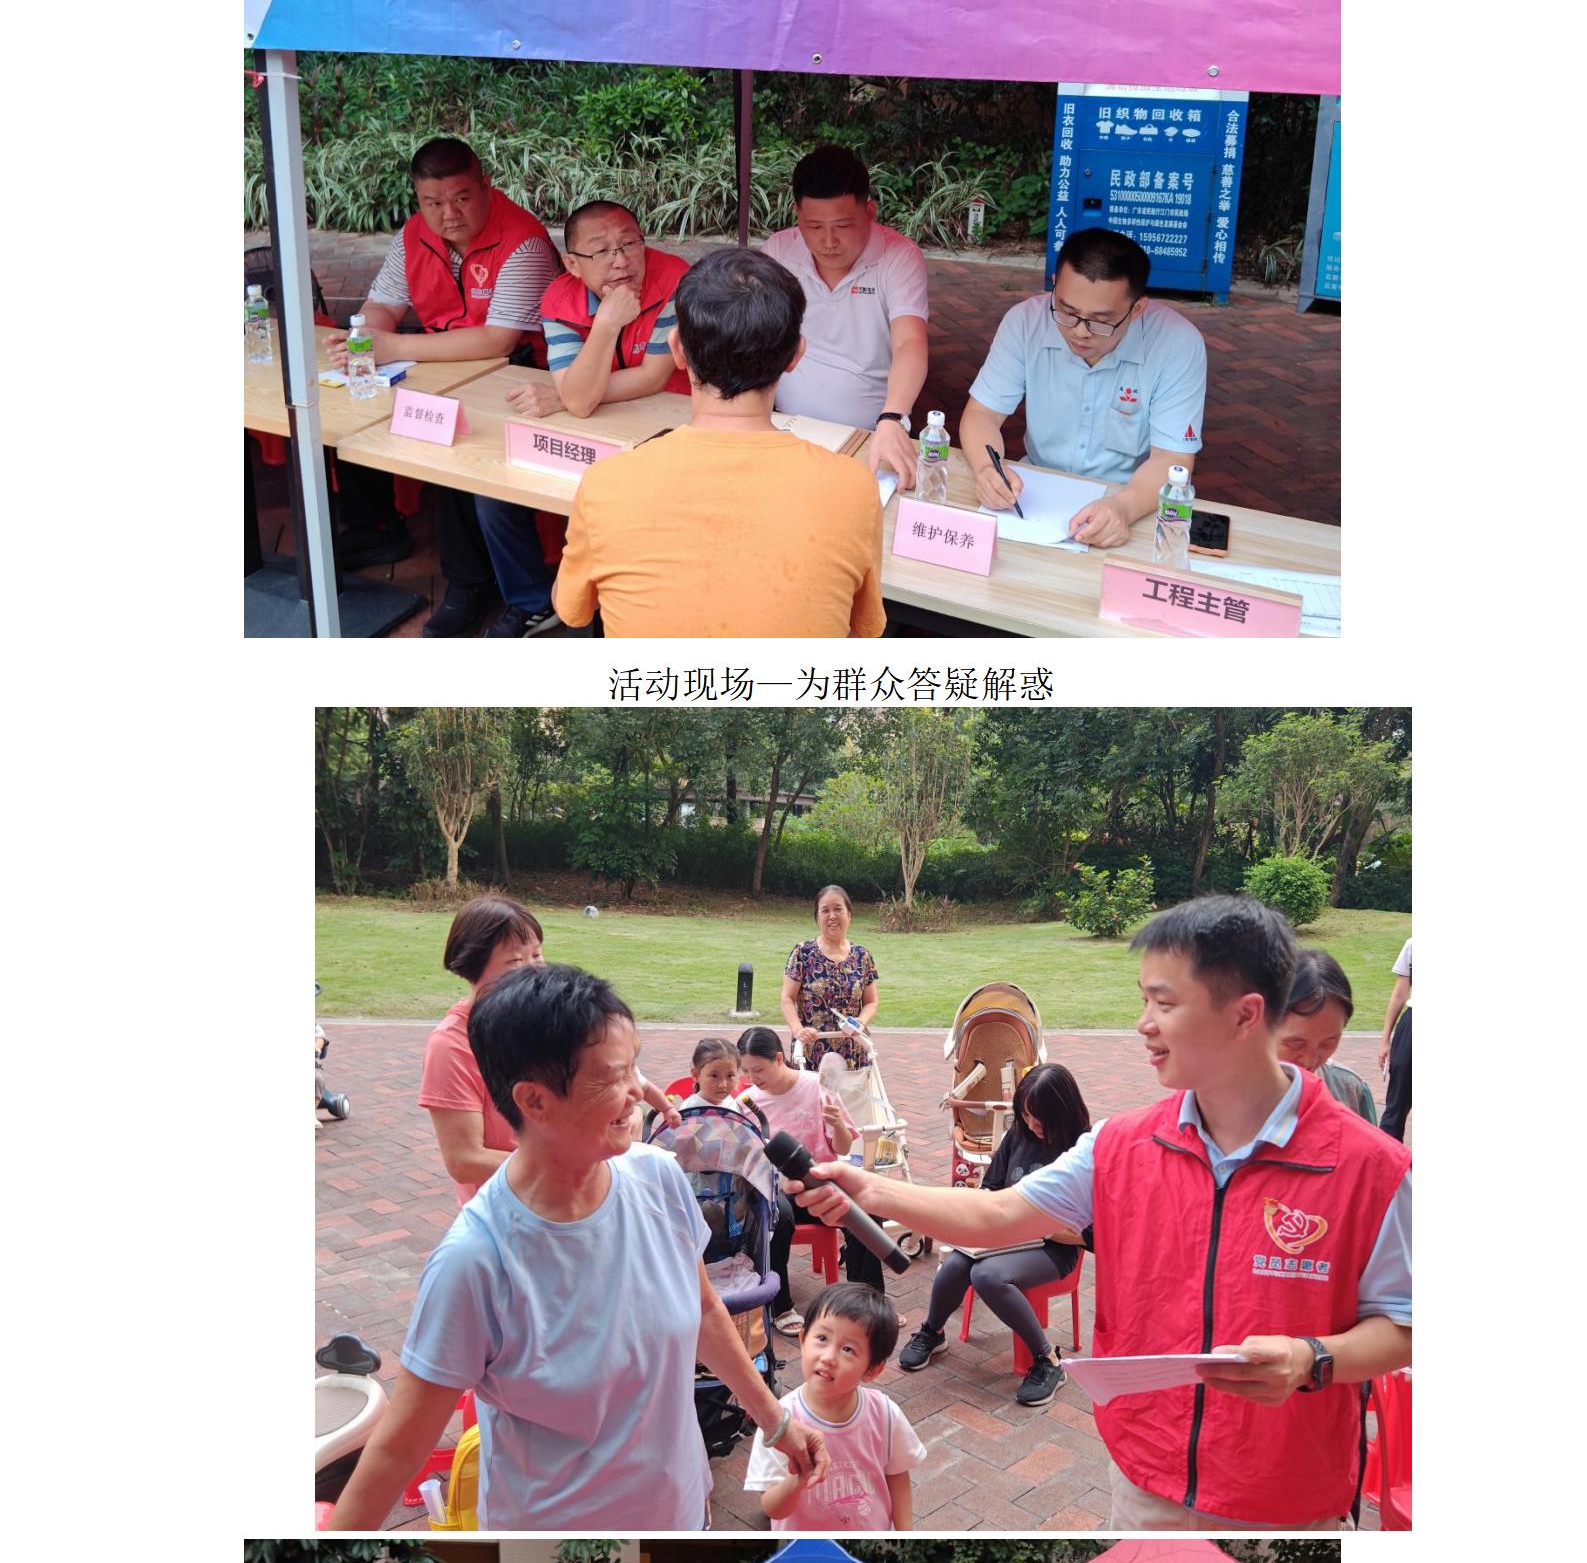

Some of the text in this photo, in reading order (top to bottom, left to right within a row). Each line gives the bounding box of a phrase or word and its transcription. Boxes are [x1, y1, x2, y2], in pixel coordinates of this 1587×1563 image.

[1060, 102, 1075, 151] 旧衣回收
[1098, 106, 1202, 122] 旧织物回收箱
[1056, 155, 1072, 202] 助力公益
[1110, 168, 1194, 191] 民政部备案号
[1213, 110, 1240, 264] 合法募捐 慈善之举 爱心相传
[403, 405, 446, 426] 监督检查
[533, 433, 597, 466] 项目经理
[911, 520, 976, 550] 维护保养
[1142, 577, 1250, 624] 工程主管
[608, 665, 1054, 702] 活动现场—为群众答疑解惑
[1252, 1253, 1331, 1275] 党员志愿者
